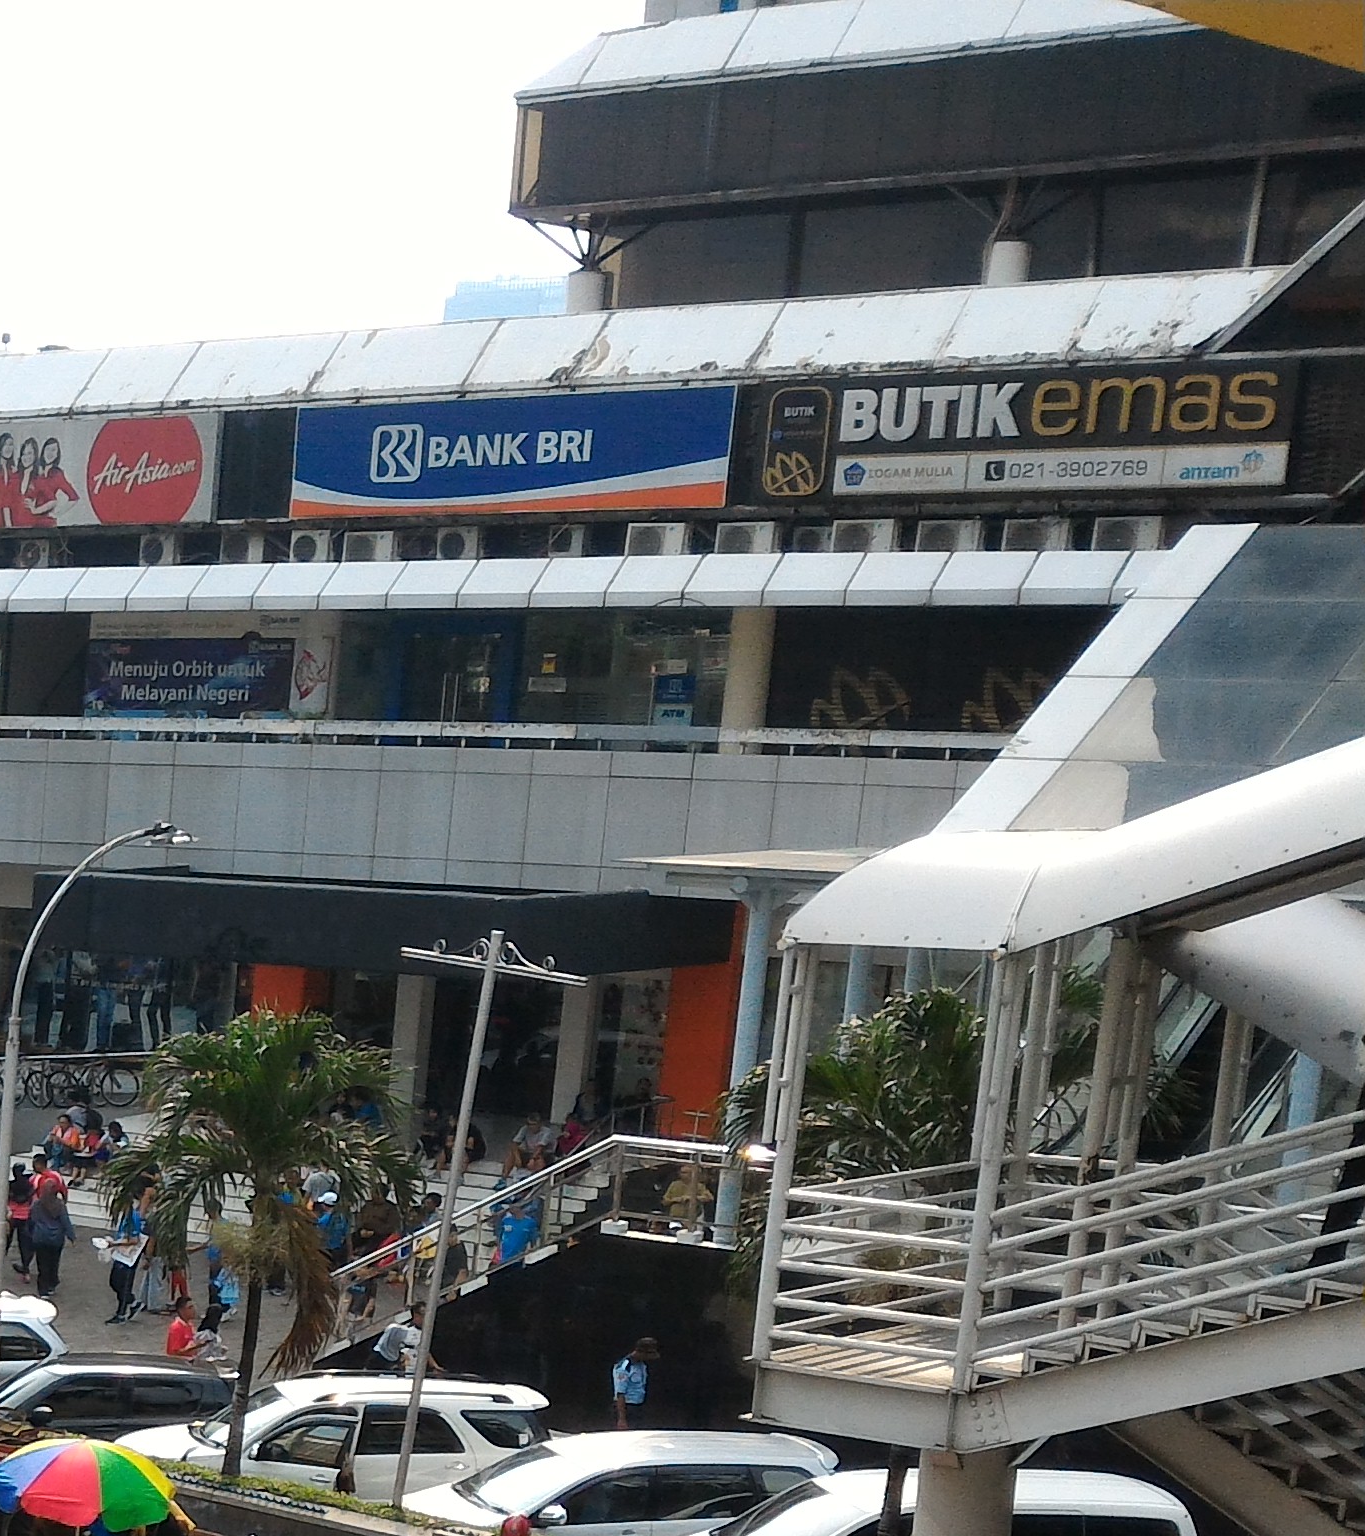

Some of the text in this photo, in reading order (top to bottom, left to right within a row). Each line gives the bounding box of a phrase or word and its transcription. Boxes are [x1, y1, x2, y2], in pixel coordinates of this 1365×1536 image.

[784, 406, 815, 418] BUTIK
[839, 371, 1278, 442] BUTIK emas
[428, 429, 593, 468] BANK BRI
[93, 452, 197, 494] AirAsia.com
[868, 468, 911, 478] LOGAM
[914, 467, 954, 478] MULIA
[1009, 460, 1148, 479] 021-3902769
[1179, 464, 1240, 480] antam
[109, 659, 266, 681] Menuju Orbit untuk
[121, 684, 250, 704] Melayani Negeri
[661, 709, 685, 718] ATM
